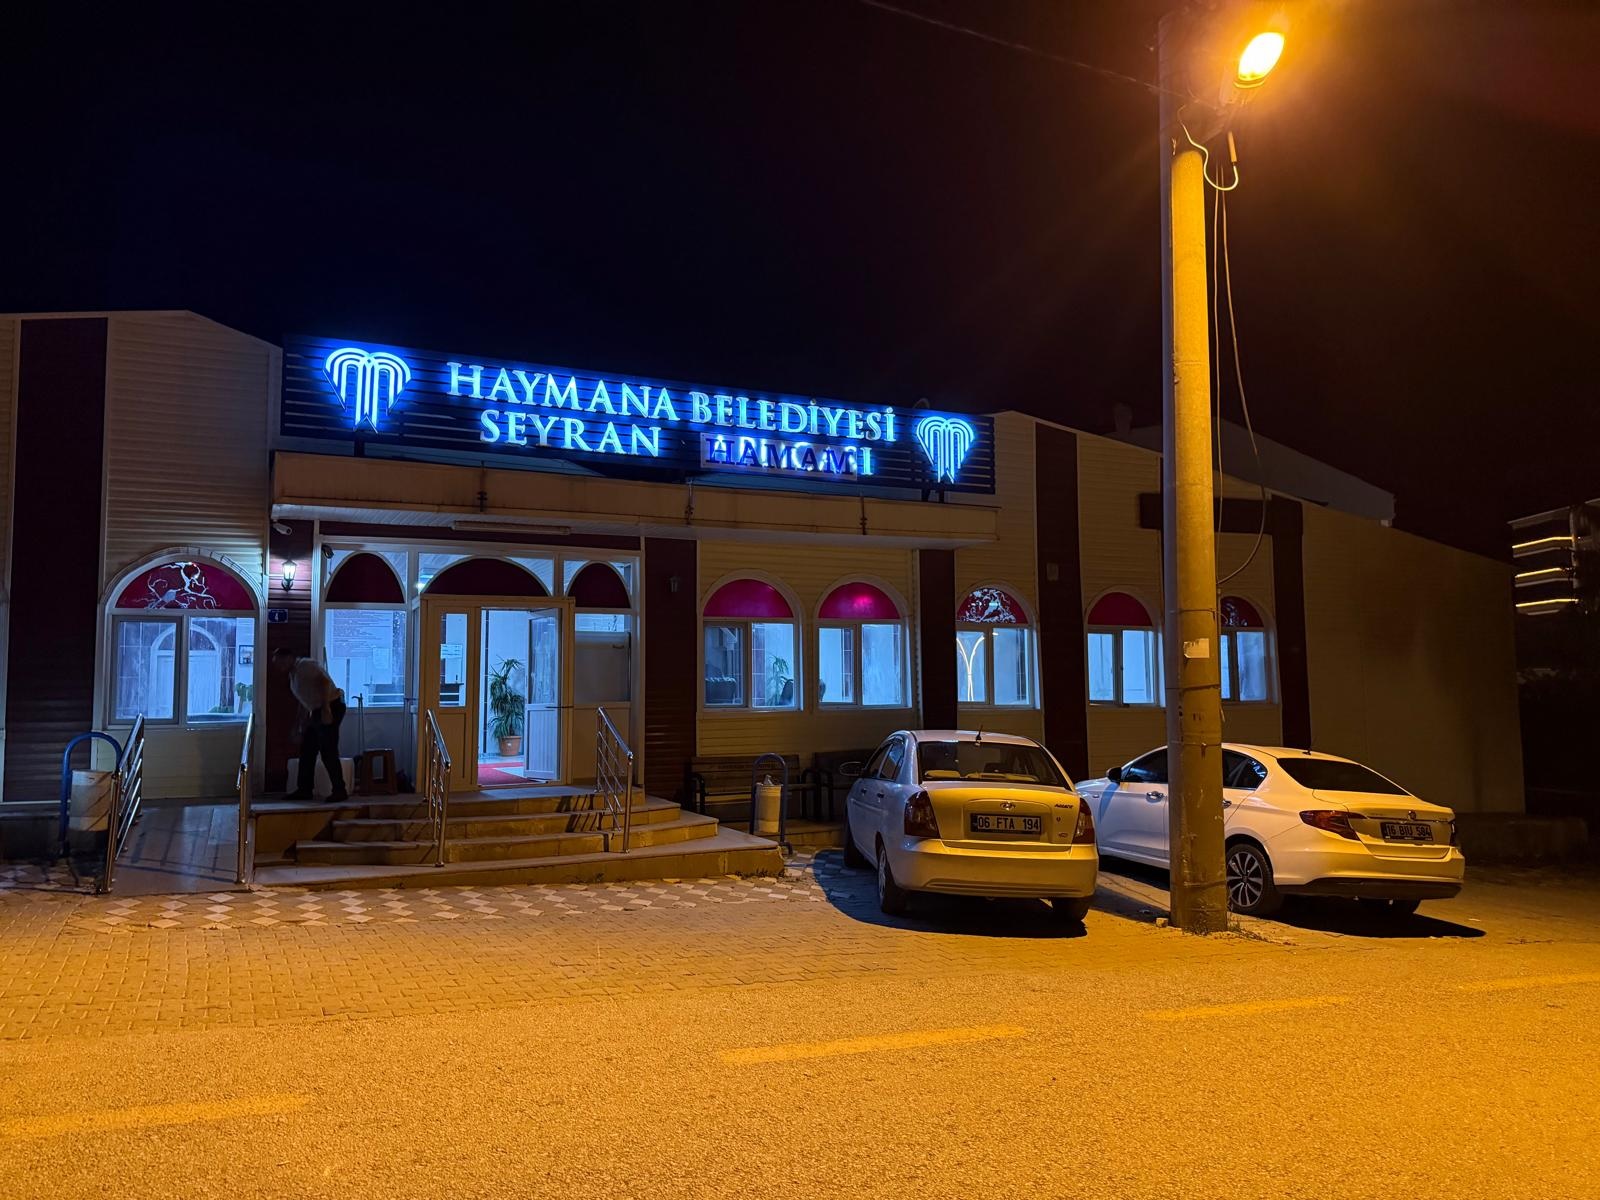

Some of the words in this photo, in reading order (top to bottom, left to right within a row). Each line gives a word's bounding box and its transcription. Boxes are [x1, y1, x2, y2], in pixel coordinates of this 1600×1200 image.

[446, 361, 680, 421] HAYMANA
[688, 391, 896, 442] BELEDİYESİ
[480, 409, 662, 457] SEYRAN
[978, 816, 991, 829] 06
[996, 817, 1015, 830] FTA
[1022, 818, 1039, 830] 194
